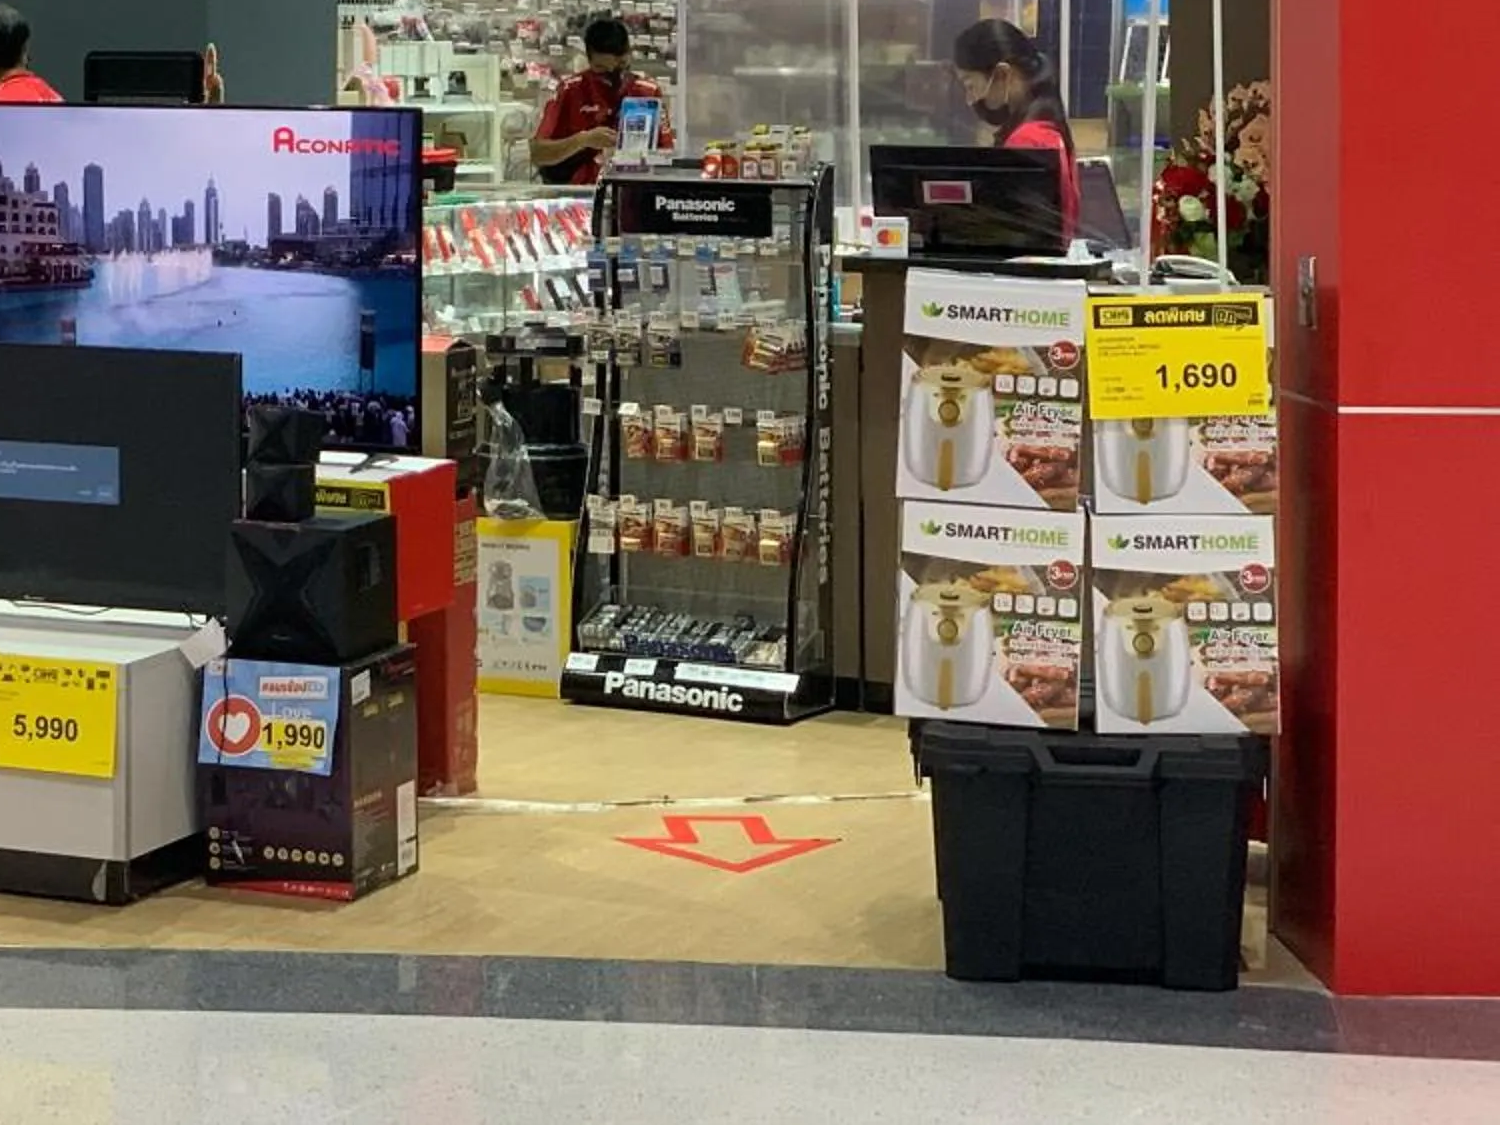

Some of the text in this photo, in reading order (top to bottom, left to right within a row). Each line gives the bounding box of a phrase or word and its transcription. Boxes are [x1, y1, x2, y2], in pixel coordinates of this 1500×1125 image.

[655, 195, 736, 212] Panasonic
[1155, 362, 1238, 394] 1,690
[604, 671, 744, 713] Panasonic
[13, 713, 78, 743] 5,990
[261, 722, 325, 750] 1,990
